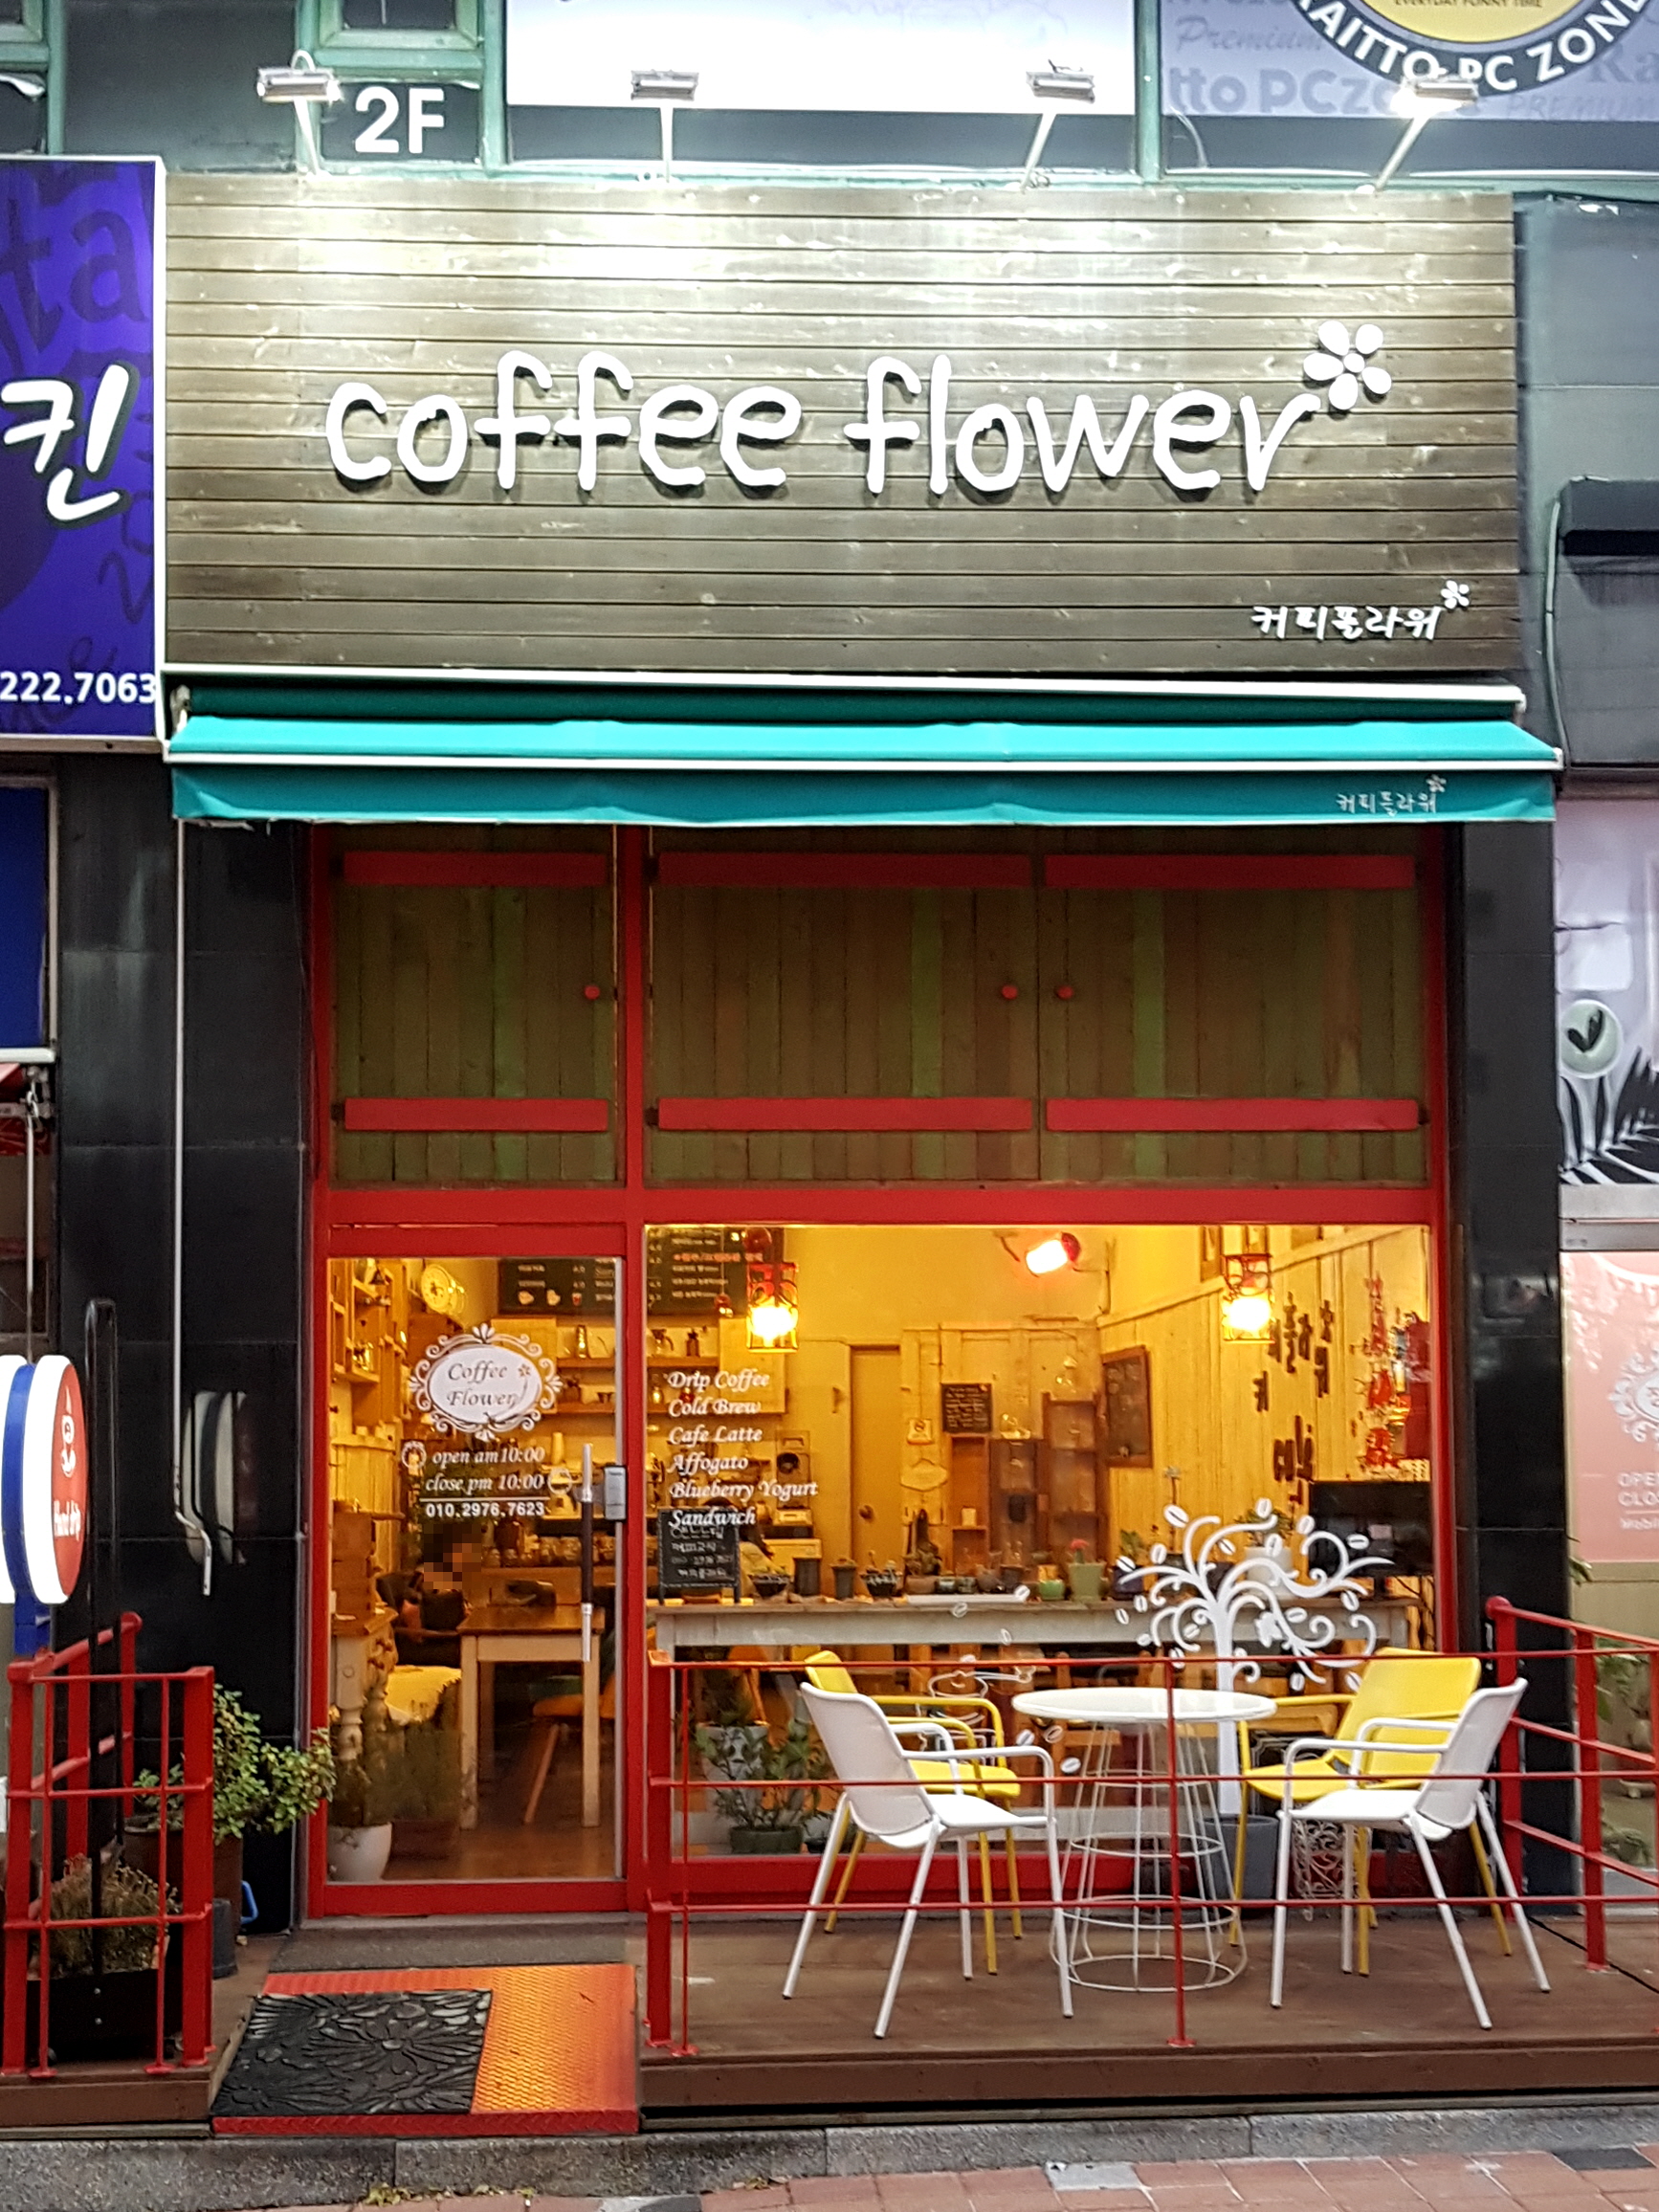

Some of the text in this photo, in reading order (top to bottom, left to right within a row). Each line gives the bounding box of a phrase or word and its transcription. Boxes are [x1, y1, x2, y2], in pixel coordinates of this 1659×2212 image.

[1458, 55, 1517, 91] PC
[355, 87, 445, 154] 2F
[326, 350, 1322, 495] coffee flower
[1250, 605, 1444, 640] 커피플라워
[1336, 790, 1437, 817] 커피플라워
[448, 1360, 508, 1384] Coffee
[667, 1368, 770, 1393] Drip Coffee
[446, 1388, 518, 1410] Flower
[668, 1398, 762, 1418] Cold Brew
[668, 1424, 763, 1446] Cafe Latte
[431, 1446, 545, 1470] open am 10:00
[666, 1451, 749, 1475] Affogato
[425, 1472, 545, 1495] close pm 10:00
[669, 1480, 819, 1502] Blueberry Yogurt
[425, 1502, 545, 1518] 010.2976.7623
[669, 1506, 756, 1527] Sandwich
